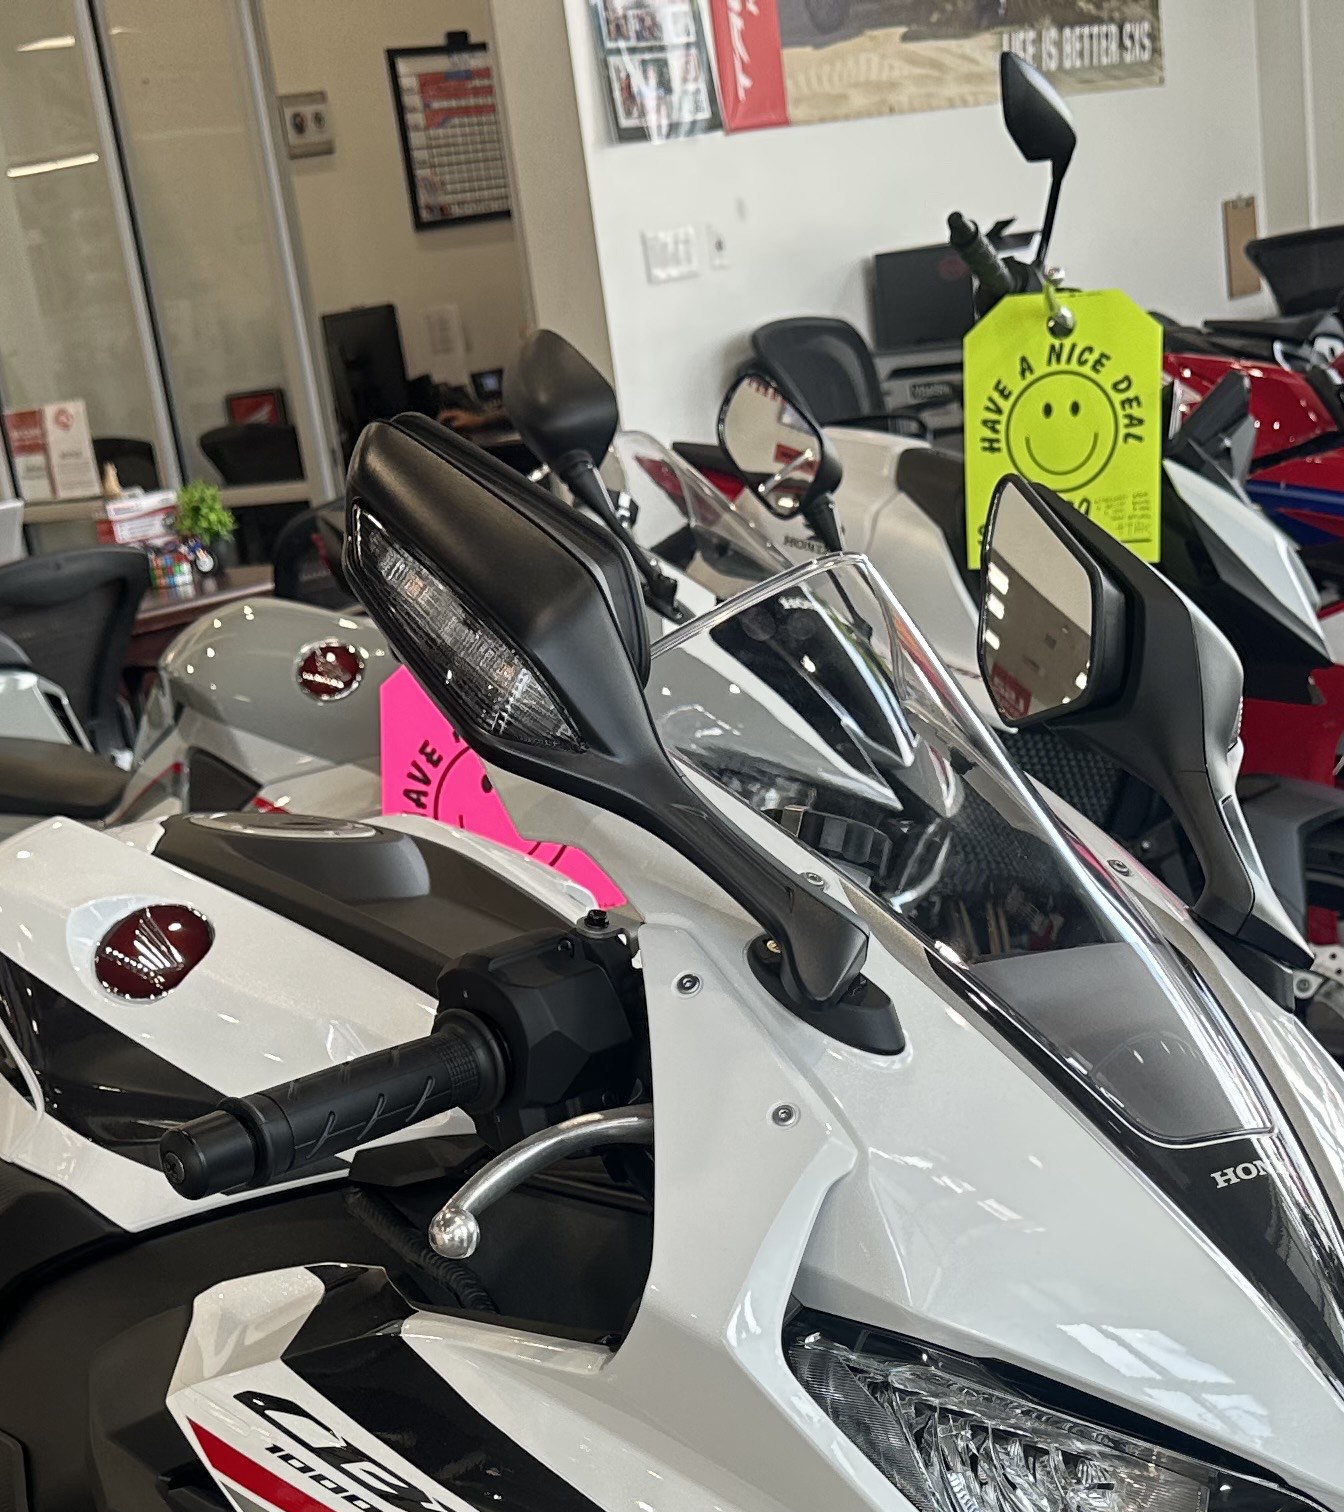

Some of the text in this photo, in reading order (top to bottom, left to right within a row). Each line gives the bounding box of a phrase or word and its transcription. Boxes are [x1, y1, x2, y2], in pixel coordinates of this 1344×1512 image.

[980, 342, 1145, 454] HAVE A NICE DEAL
[402, 739, 444, 813] AVE
[1210, 1159, 1270, 1189] HON
